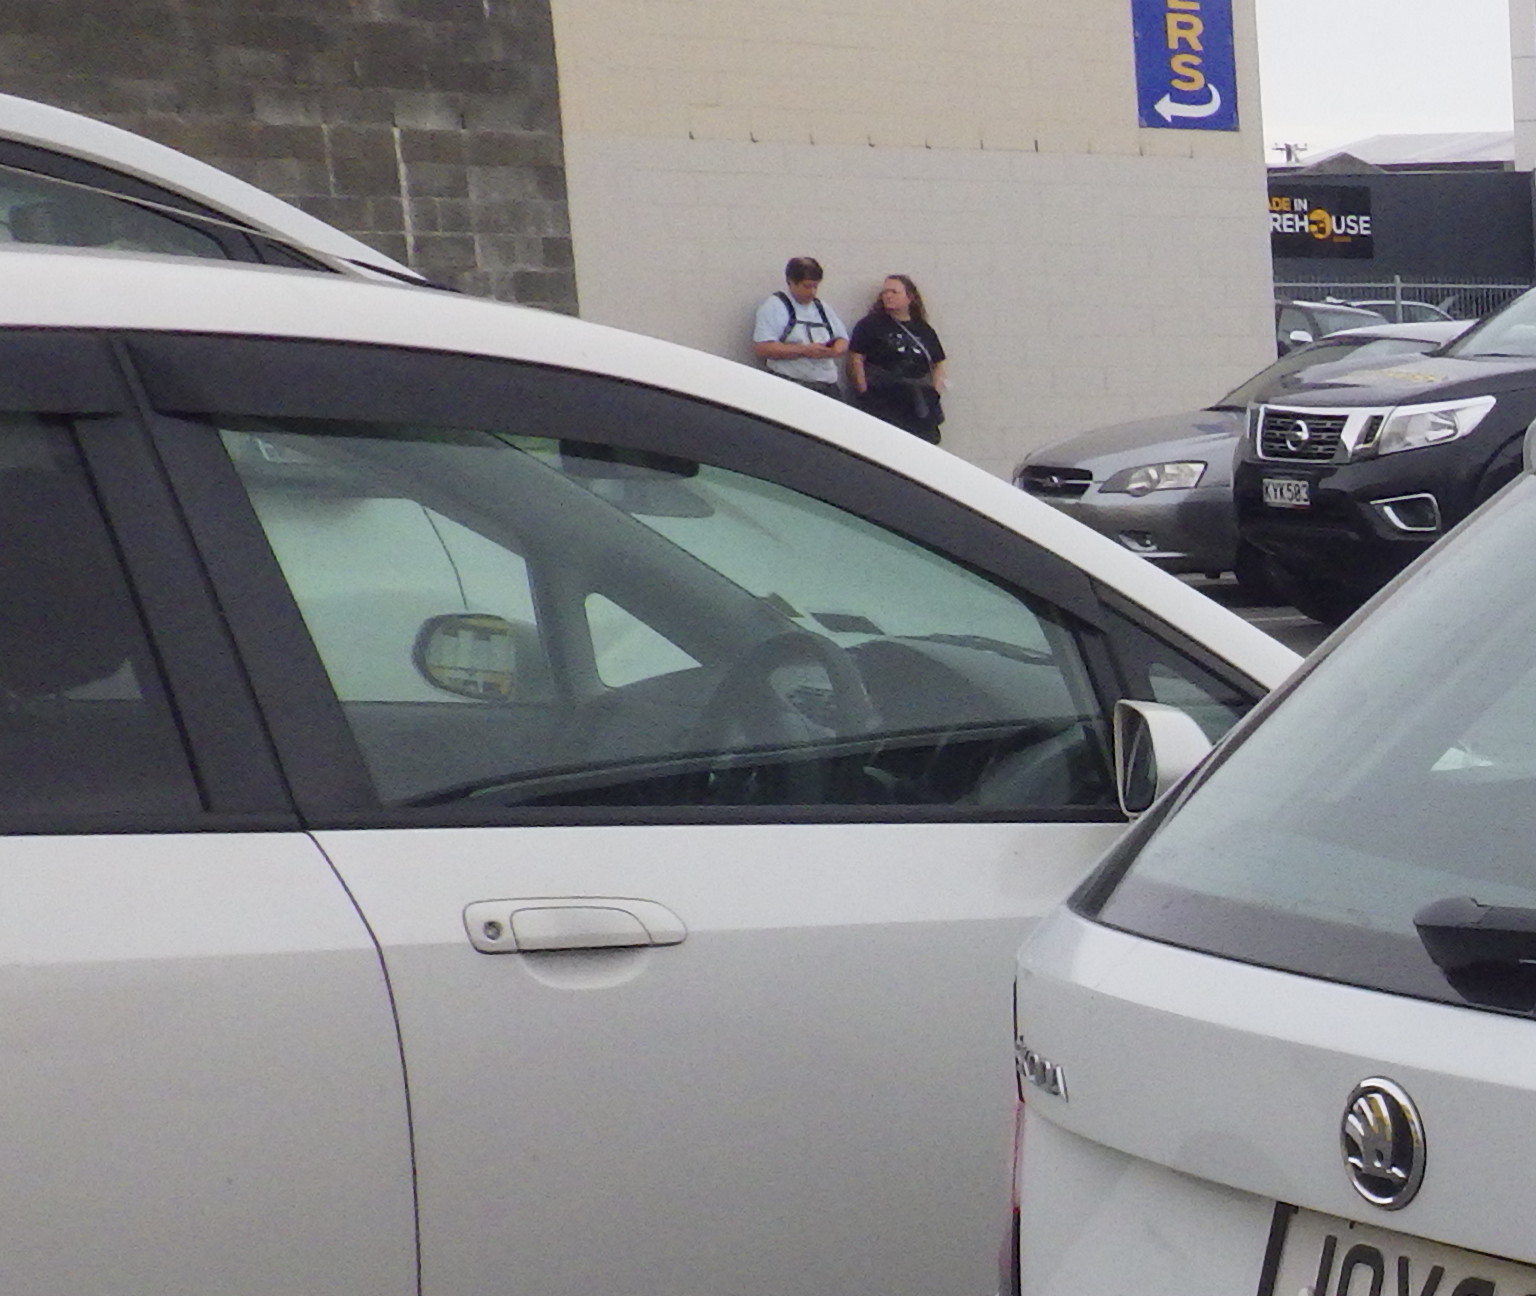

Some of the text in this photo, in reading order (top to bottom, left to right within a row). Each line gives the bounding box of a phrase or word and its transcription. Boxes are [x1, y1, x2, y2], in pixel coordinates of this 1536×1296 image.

[1164, 0, 1206, 91] RS
[1269, 197, 1308, 212] DE IN
